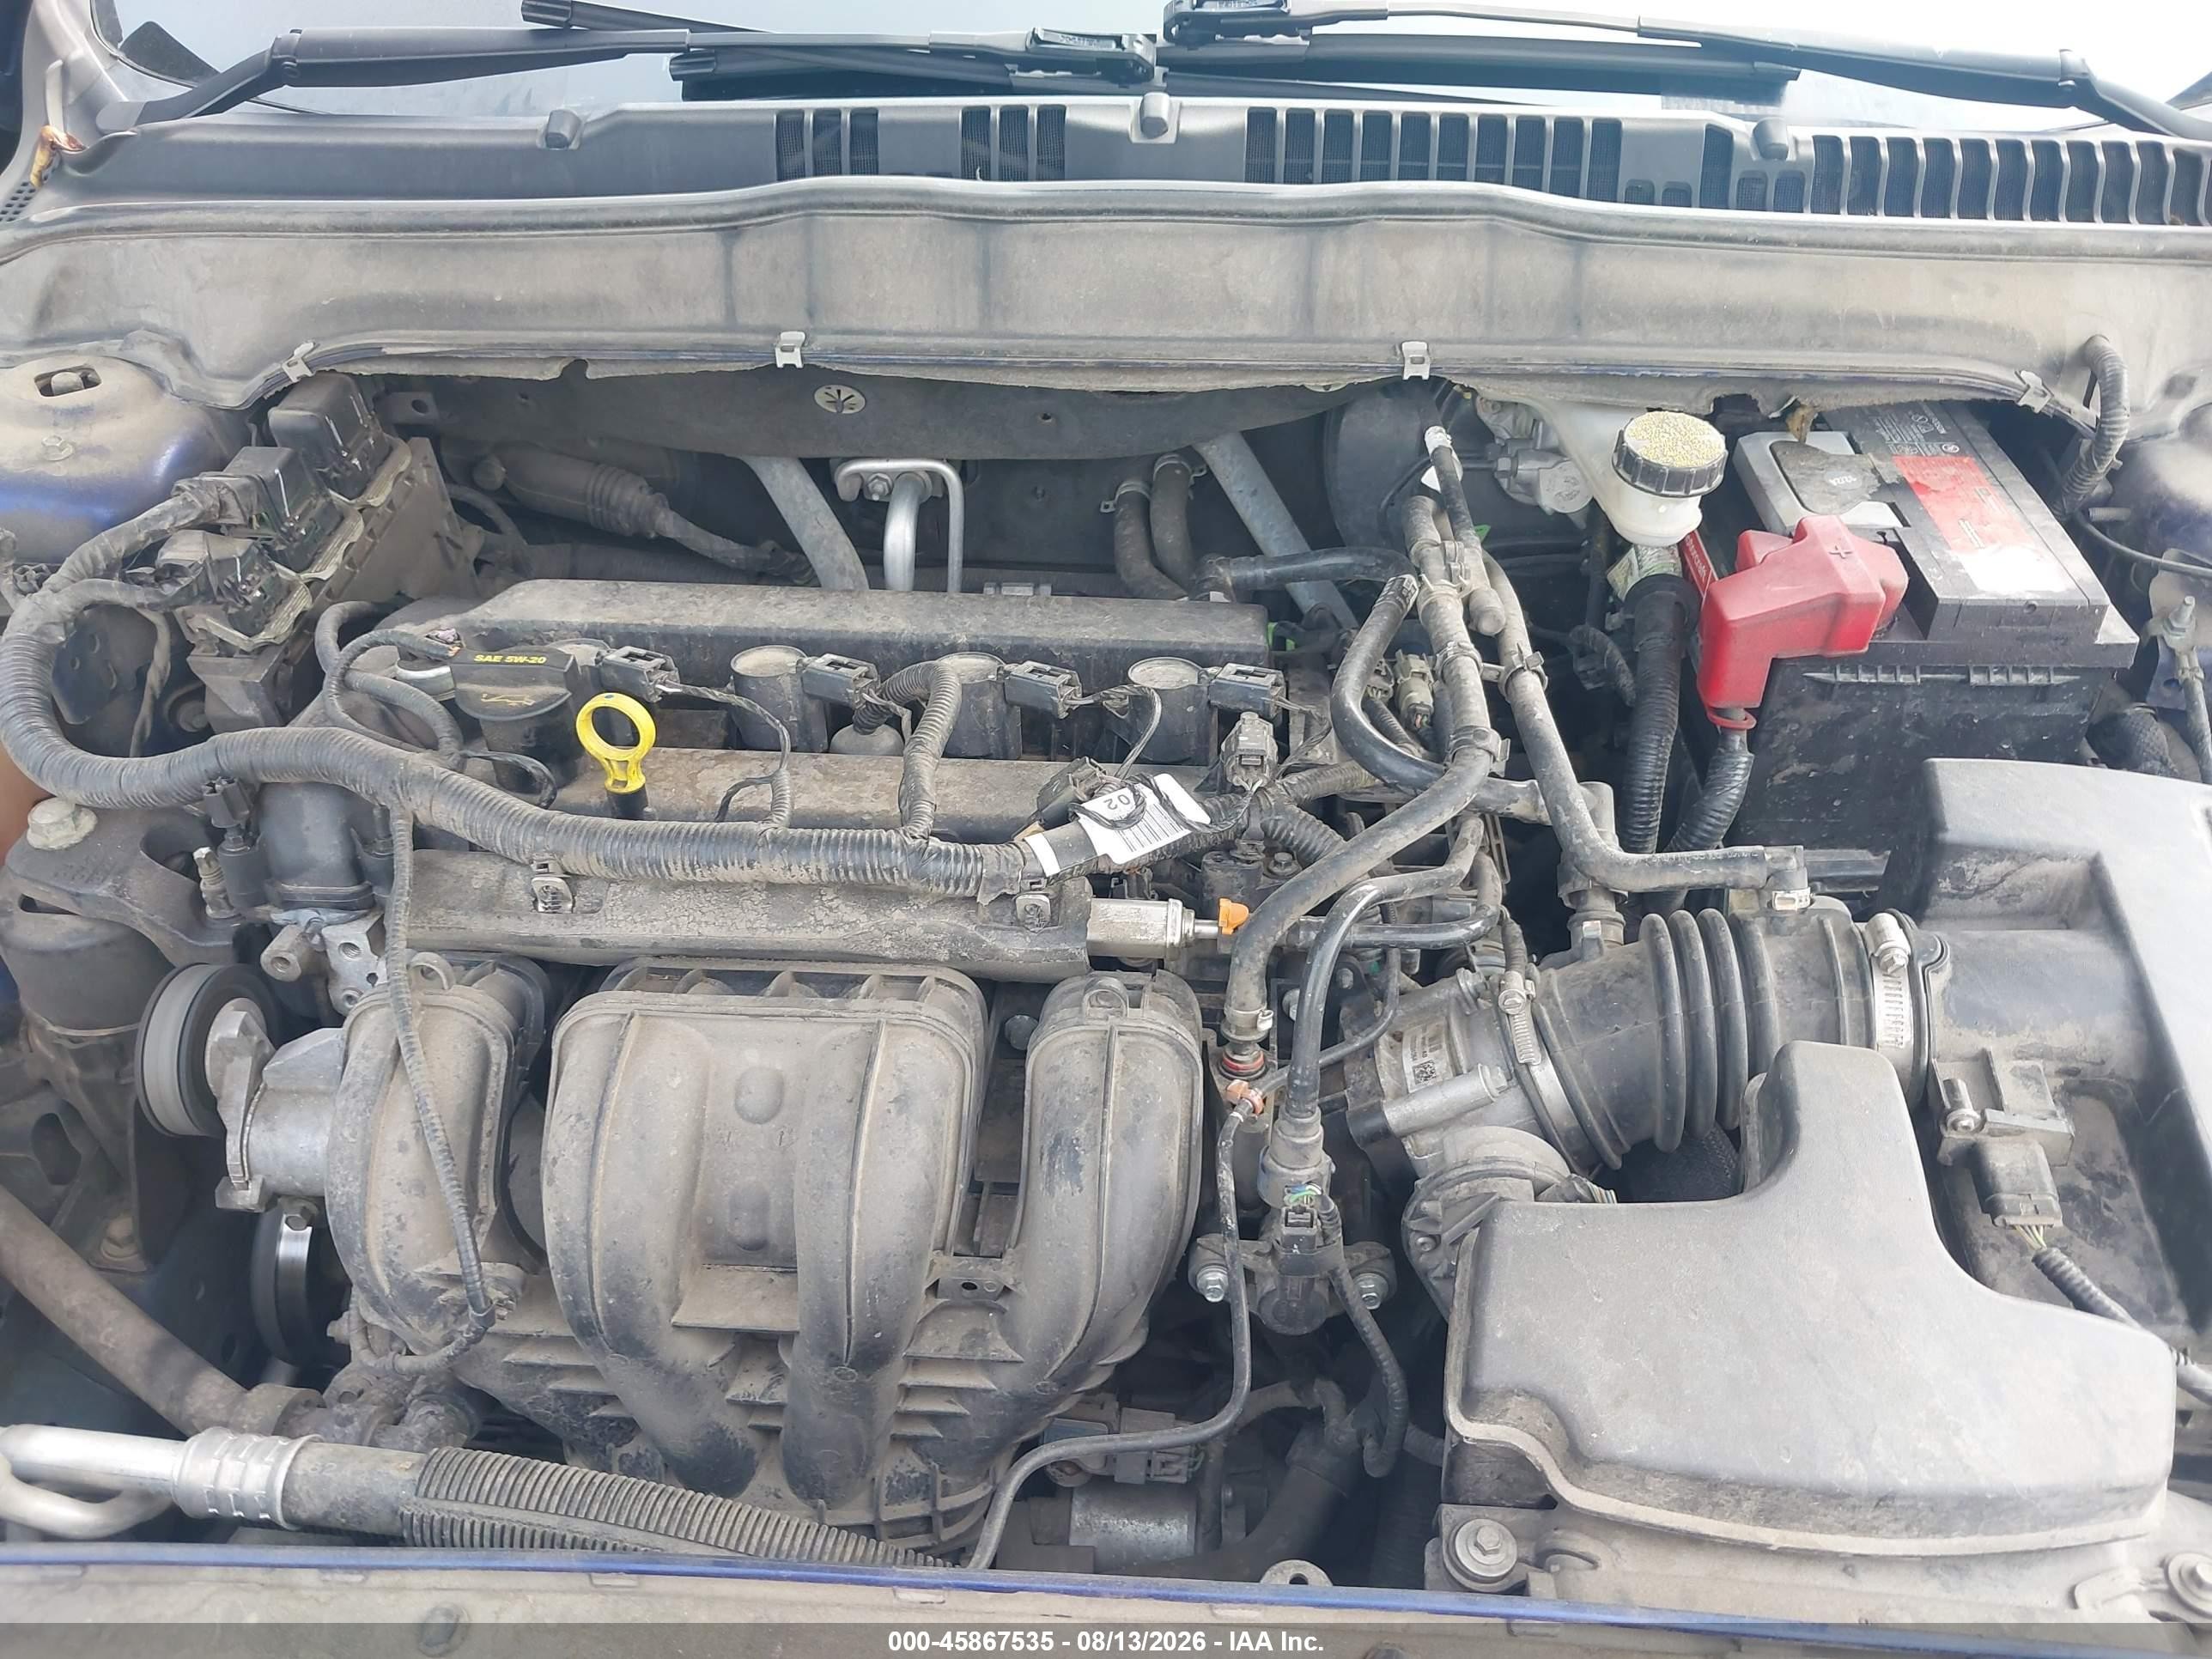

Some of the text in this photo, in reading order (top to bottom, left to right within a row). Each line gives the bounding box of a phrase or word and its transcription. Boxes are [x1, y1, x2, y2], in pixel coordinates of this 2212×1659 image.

[473, 653, 548, 665] SAE 5W-20
[1103, 793, 1131, 811] 02
